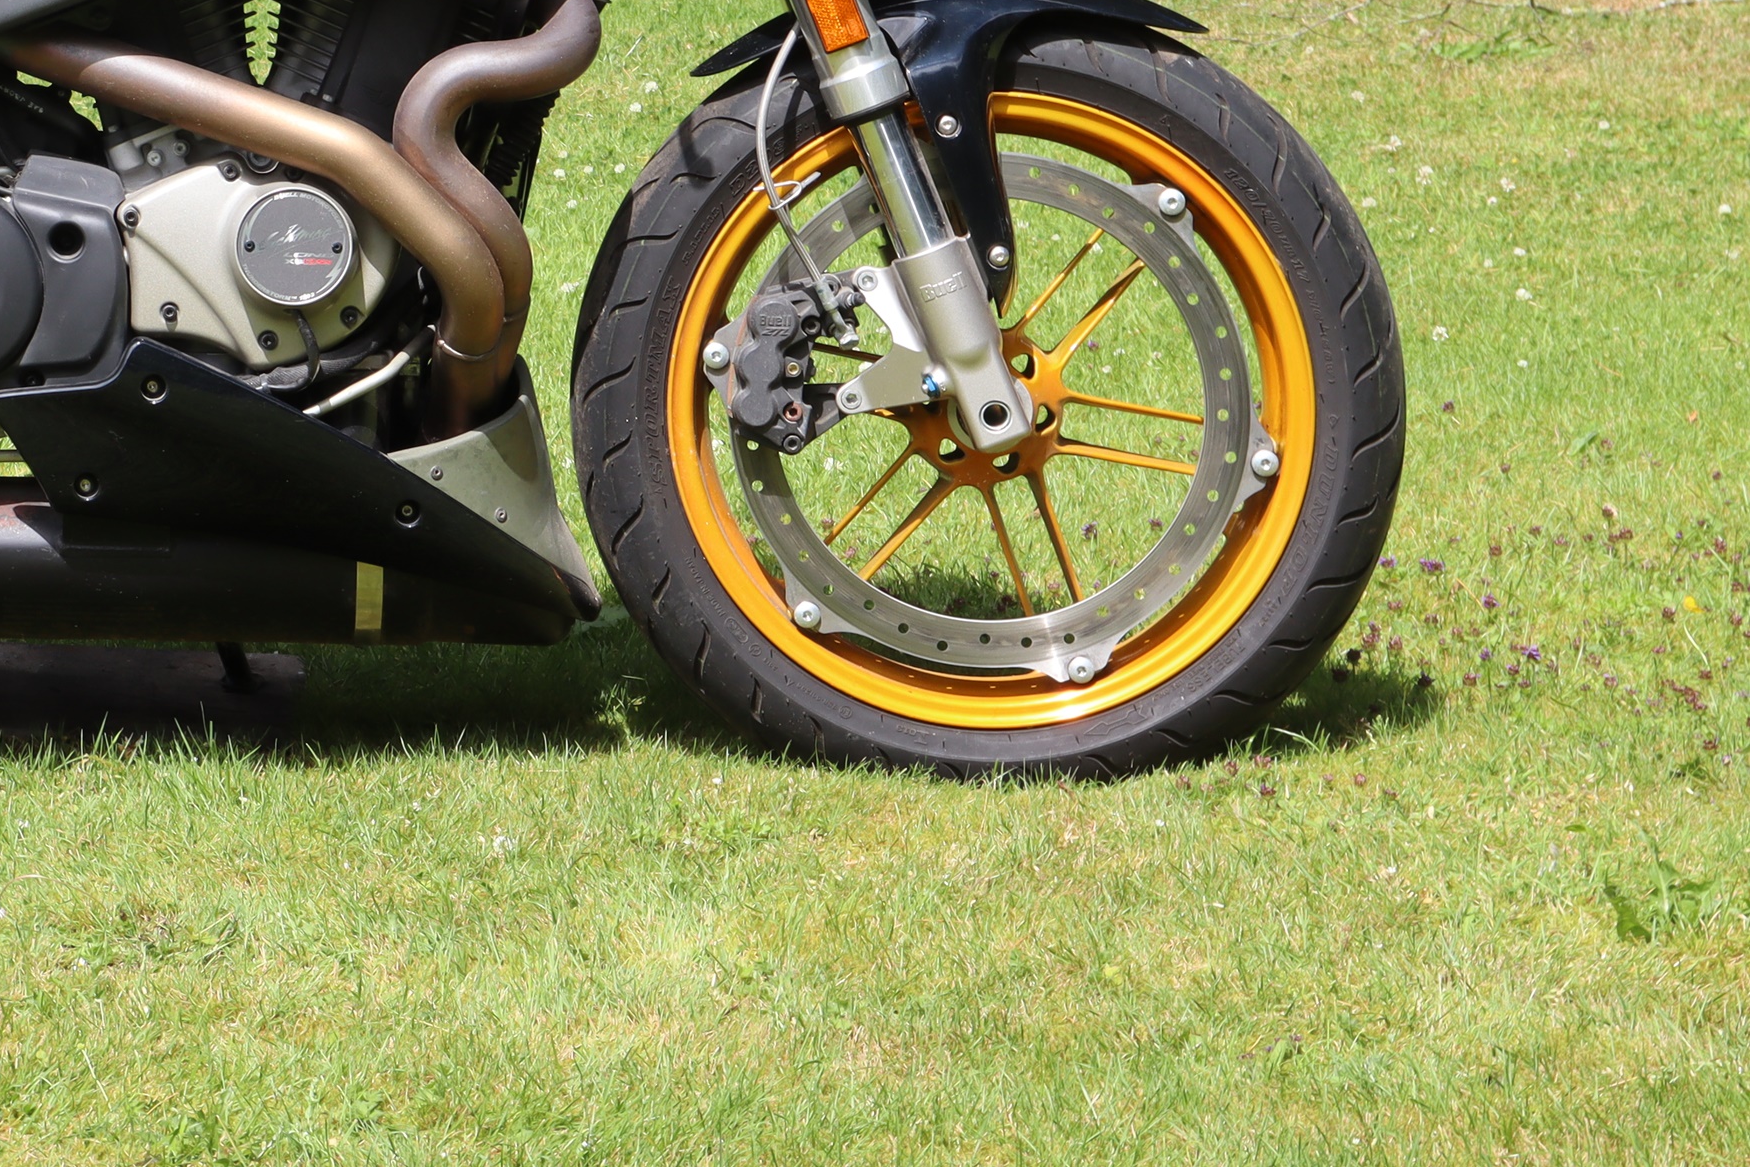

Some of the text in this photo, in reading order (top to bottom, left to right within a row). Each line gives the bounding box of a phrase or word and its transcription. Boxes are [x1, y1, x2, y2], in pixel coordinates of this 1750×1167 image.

[759, 313, 792, 327] Buell
[920, 272, 968, 303] Buell
[644, 275, 683, 484] SPORTMAX
[1280, 444, 1339, 600] DUNLOP
